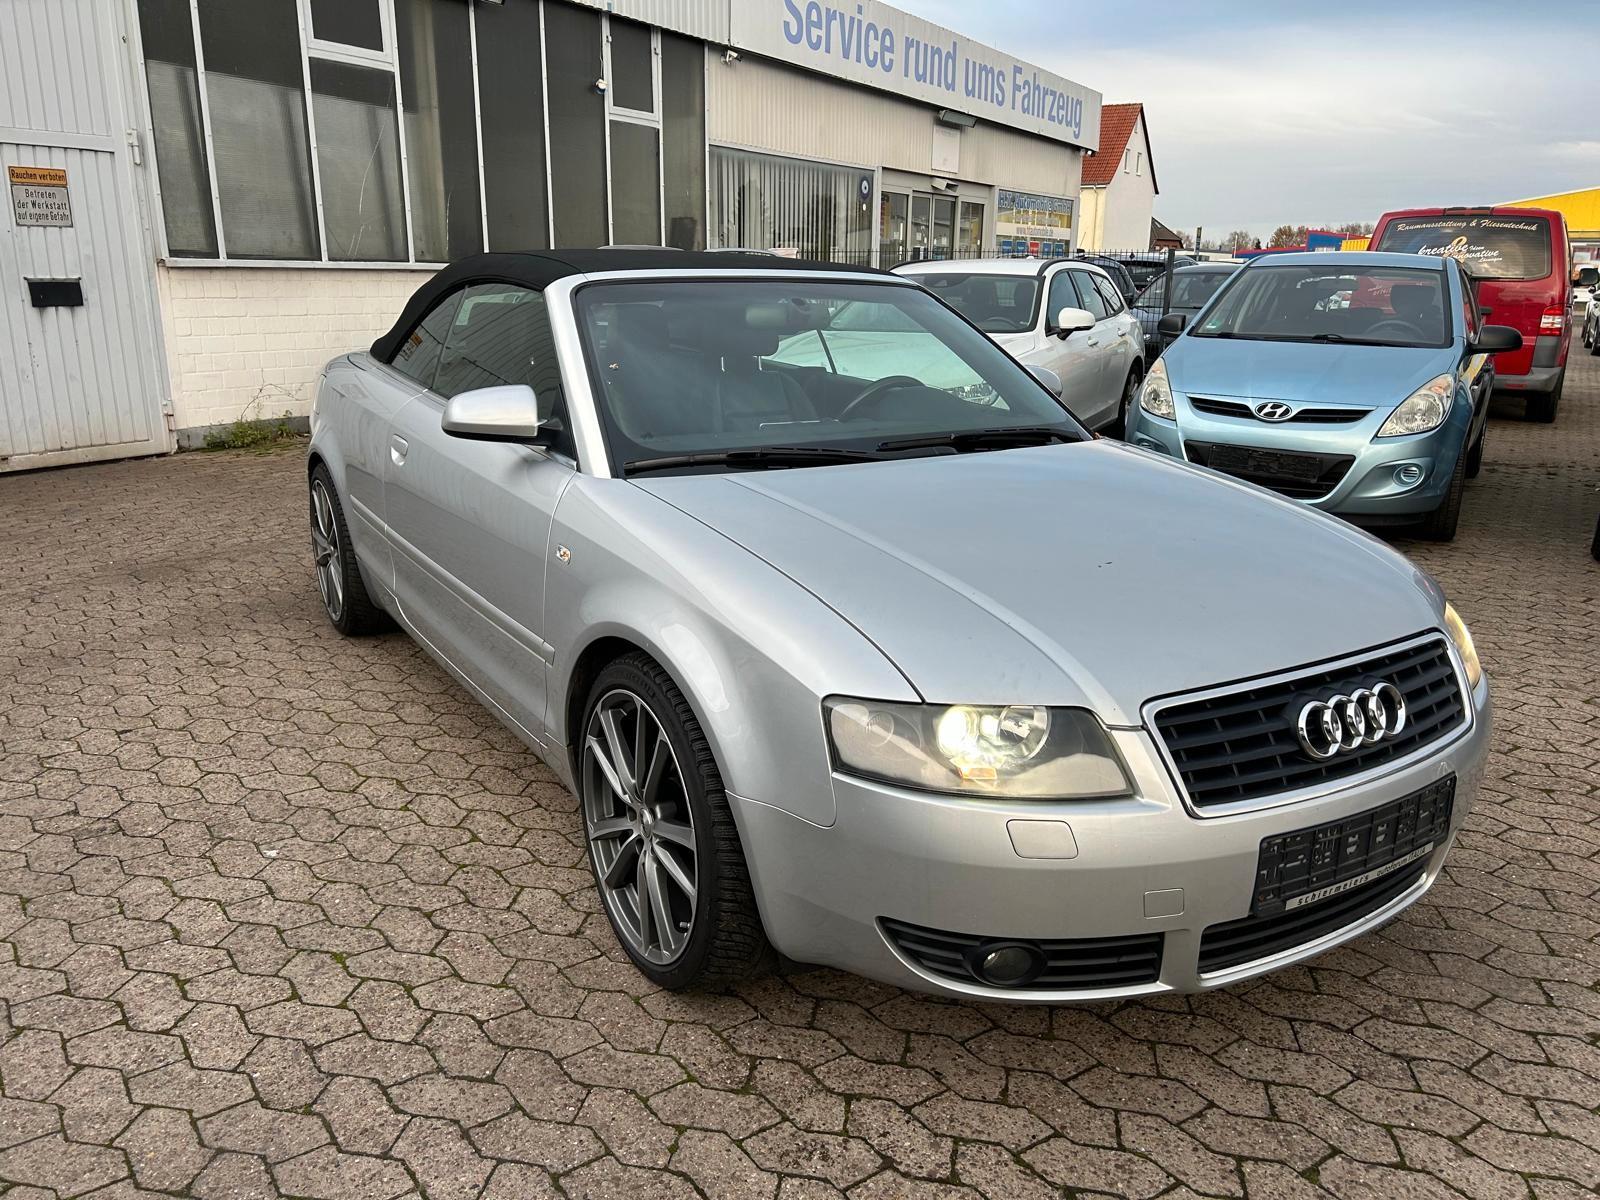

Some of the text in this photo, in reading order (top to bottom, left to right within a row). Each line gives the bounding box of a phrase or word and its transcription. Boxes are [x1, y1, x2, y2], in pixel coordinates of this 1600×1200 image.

[783, 0, 1083, 139] Service rund ums Fahrzeug
[11, 169, 65, 181] Rauchen verboten
[25, 189, 57, 199] Betreten
[17, 200, 67, 210] der Werkstatt
[18, 210, 69, 222] auf eigene Gefahr
[1470, 219, 1477, 227] &
[1481, 219, 1539, 231] Fliesentechnik
